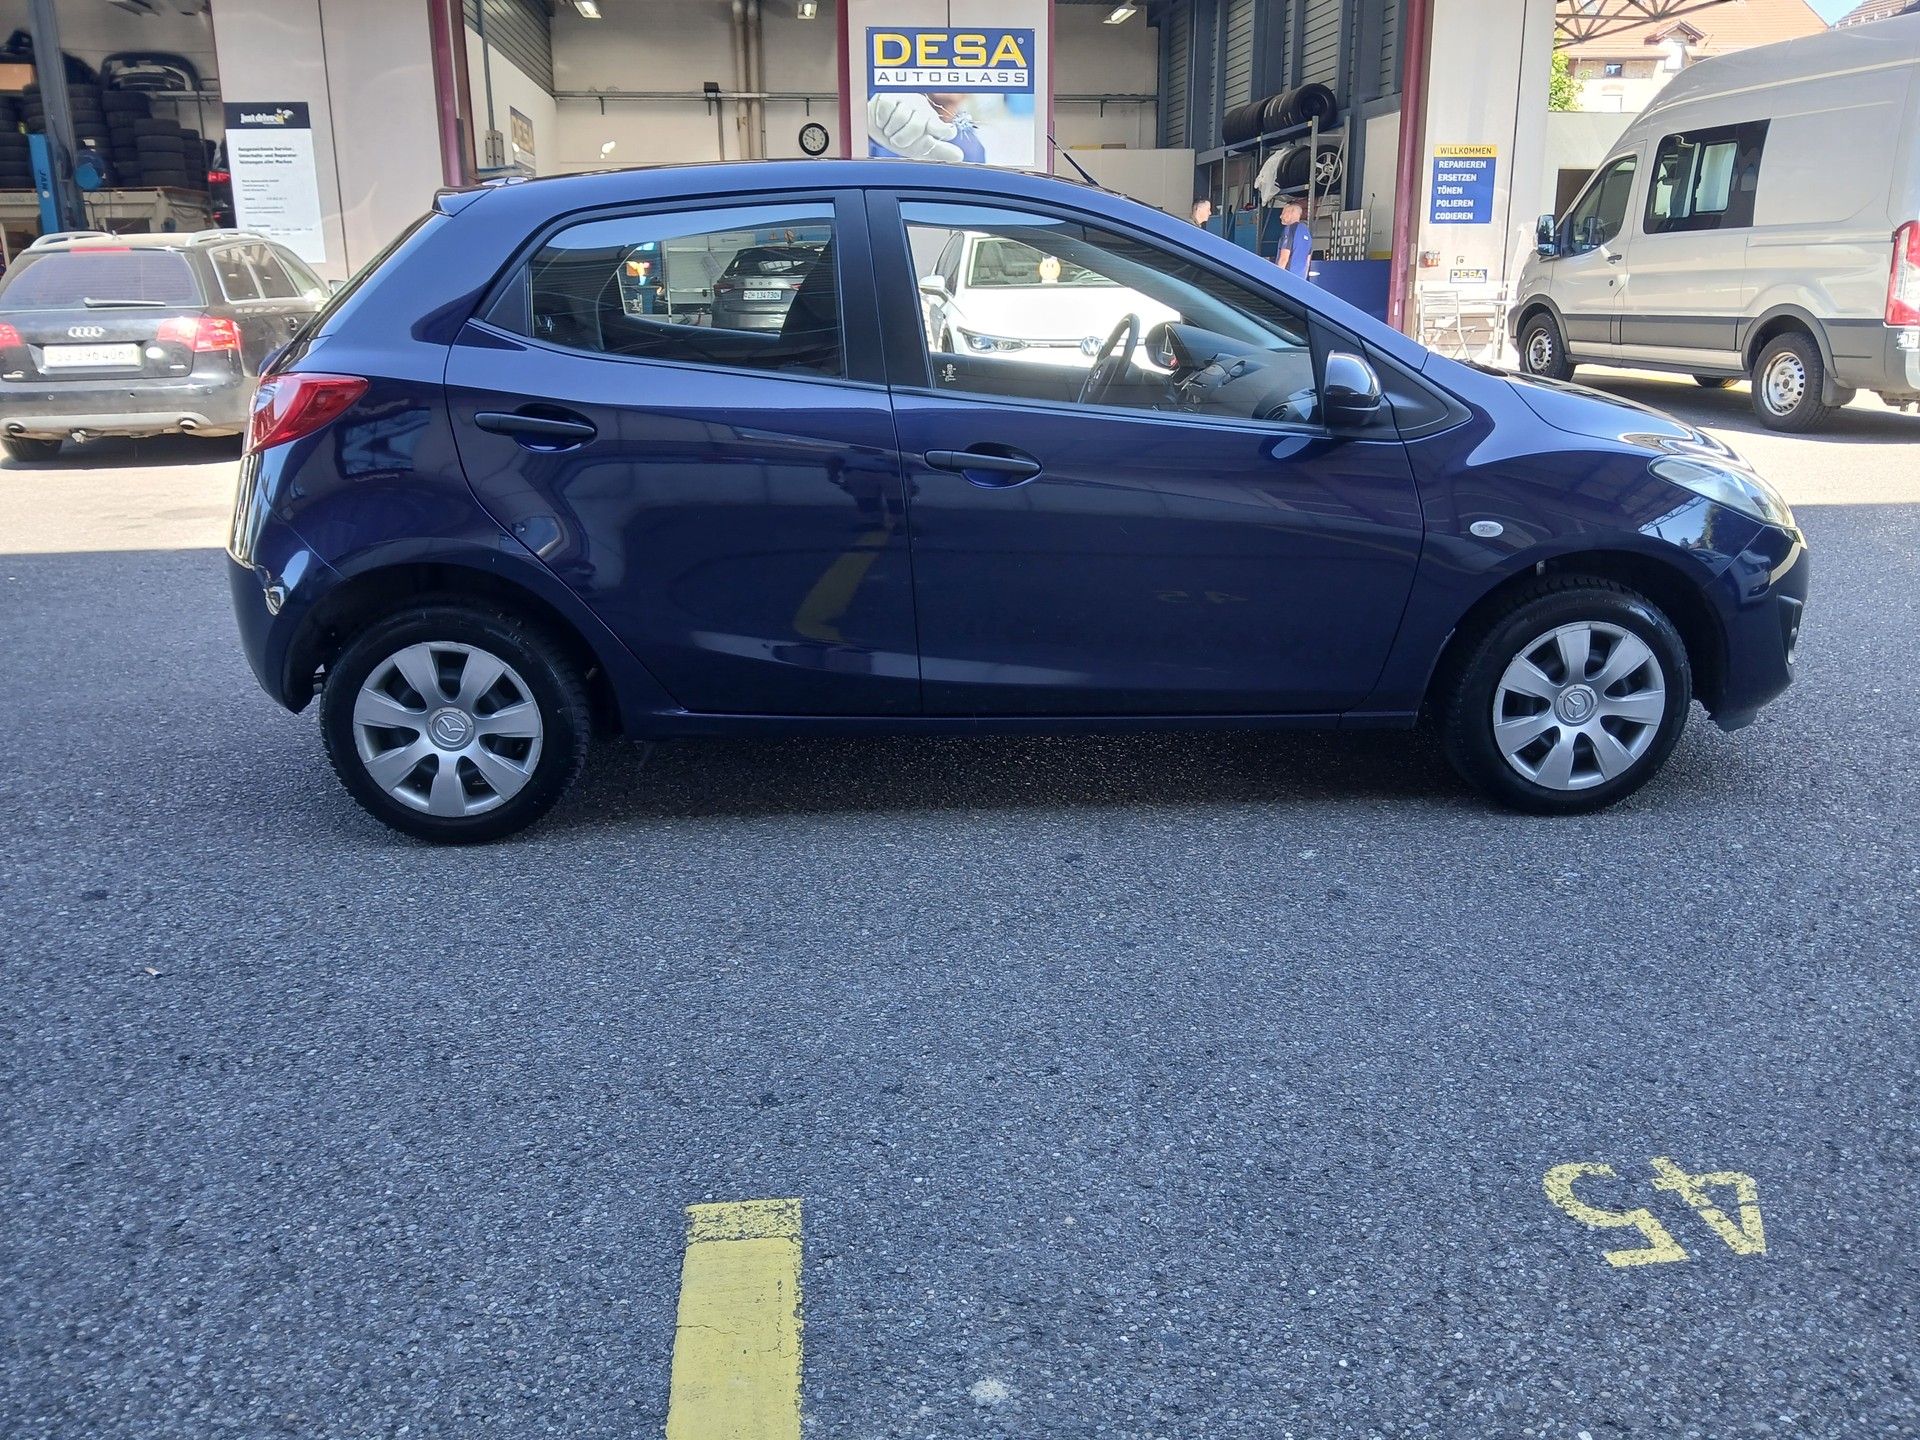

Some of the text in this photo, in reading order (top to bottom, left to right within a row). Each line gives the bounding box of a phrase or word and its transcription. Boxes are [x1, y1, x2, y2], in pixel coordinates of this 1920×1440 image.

[873, 33, 1027, 67] DESA
[877, 71, 1025, 83] AUTOGLASS
[1440, 147, 1492, 155] WILLKOMMEN
[1438, 160, 1487, 169] REPARIEREN
[1437, 173, 1477, 182] ERSETZEN
[1437, 185, 1463, 195] TÖNEN
[1436, 199, 1474, 208] POLIEREN
[1435, 212, 1474, 221] CODIEREN
[1451, 270, 1484, 278] DESA
